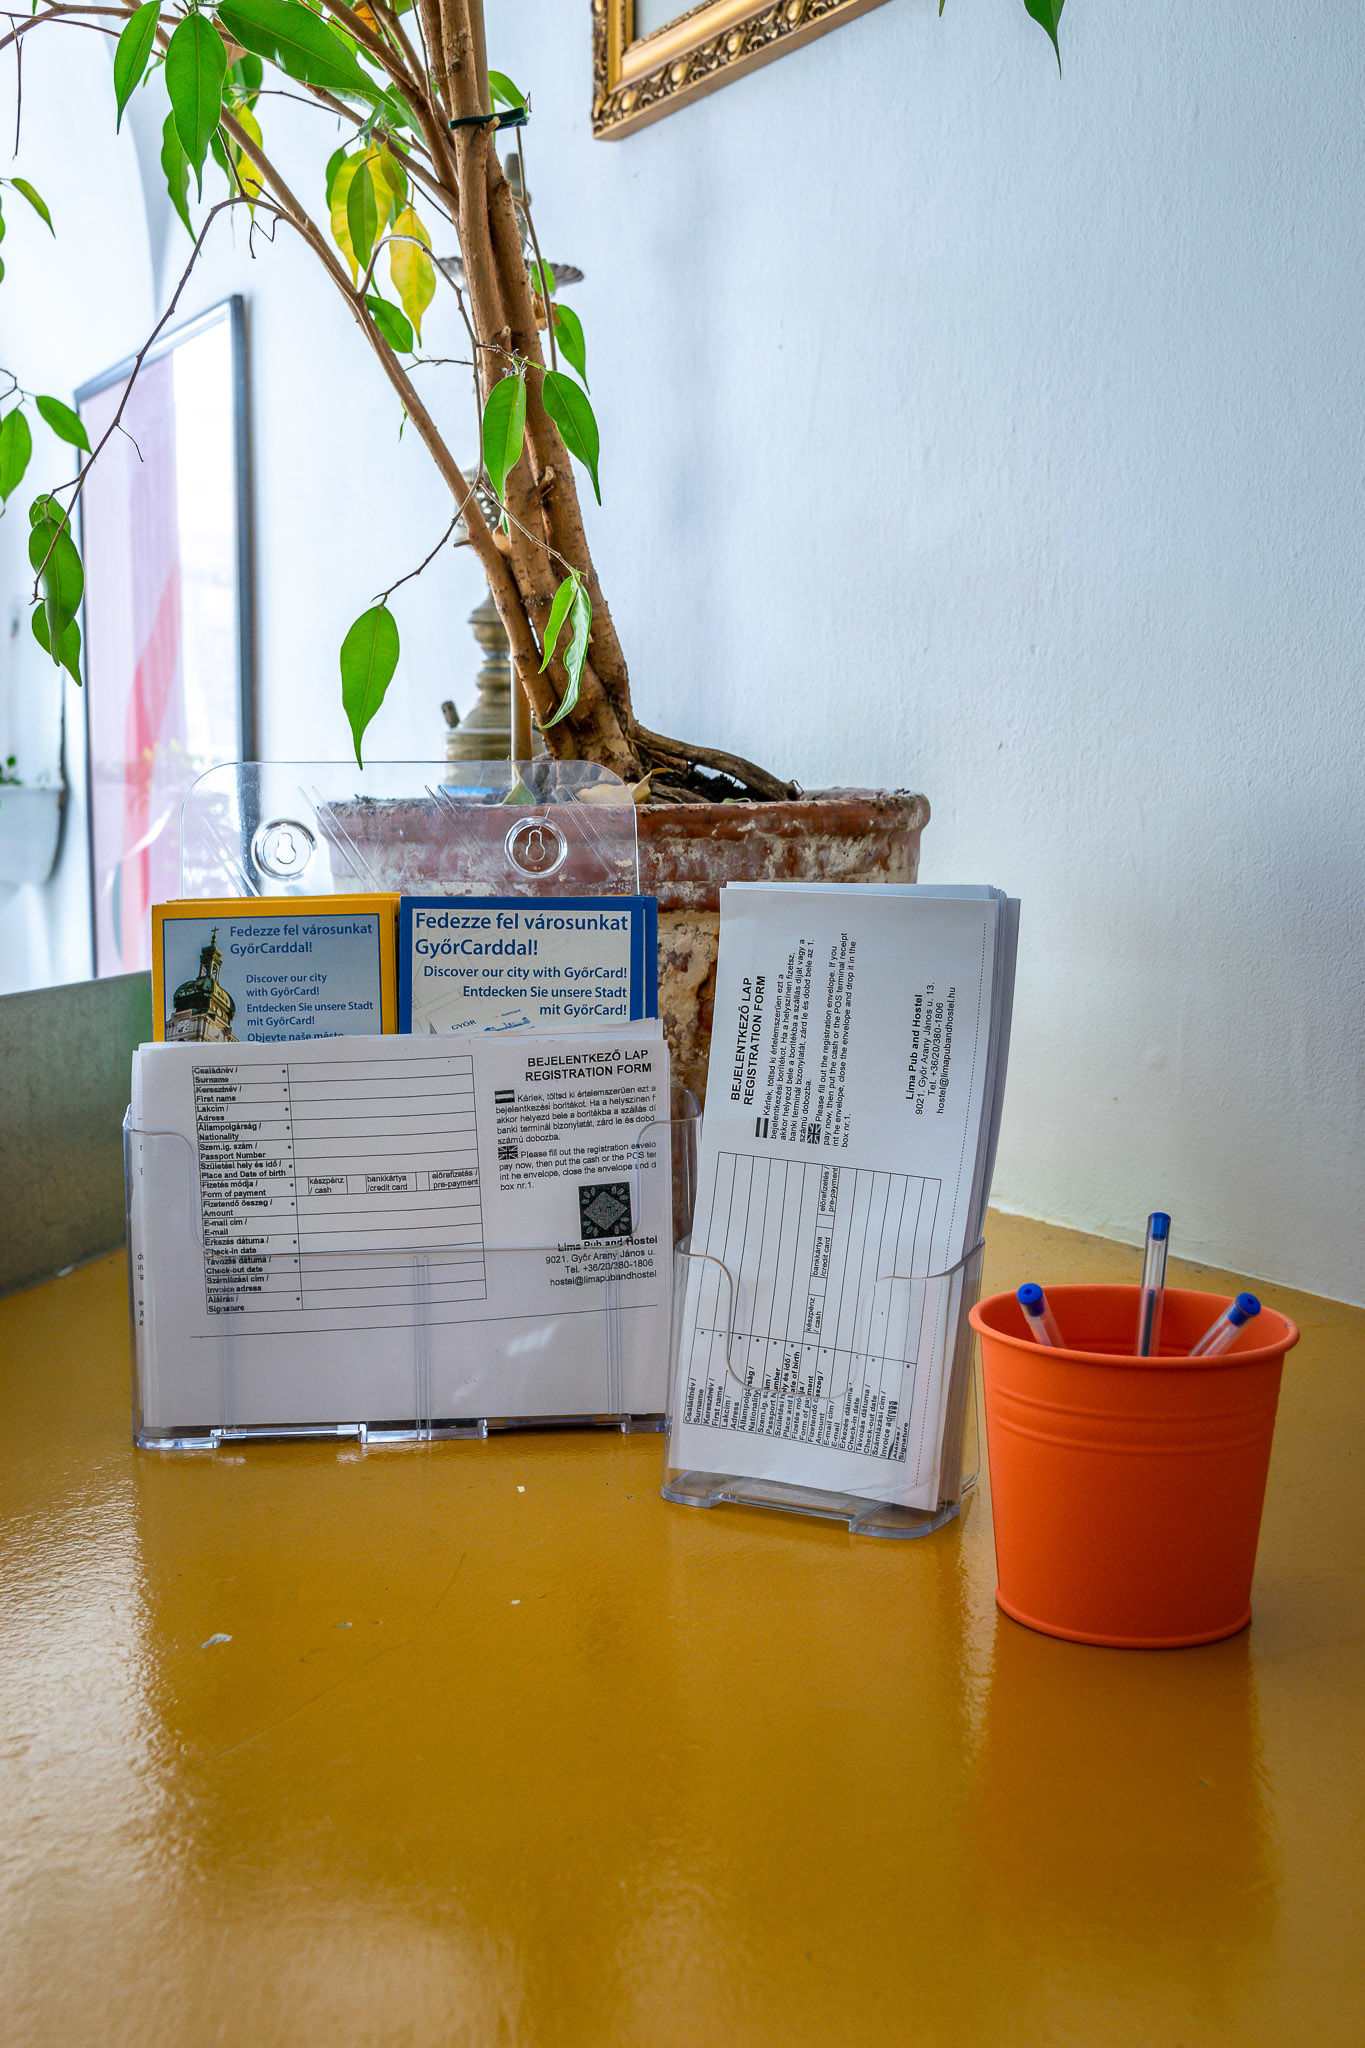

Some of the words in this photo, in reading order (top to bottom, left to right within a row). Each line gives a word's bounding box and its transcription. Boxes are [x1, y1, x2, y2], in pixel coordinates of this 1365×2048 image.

[230, 925, 280, 937] Fedezze
[284, 925, 299, 936] fel
[302, 923, 372, 935] városunkat
[416, 912, 491, 929] Fedezze
[497, 913, 518, 929] fel
[524, 913, 628, 930] városunkat
[230, 941, 312, 957] GyőrCarddal!
[415, 939, 538, 959] GyőrCarddal!
[807, 949, 813, 958] az
[840, 932, 848, 959] receipt
[424, 966, 478, 977] Discover
[482, 969, 504, 977] our
[507, 966, 529, 980] city
[533, 966, 560, 978] with
[564, 967, 627, 981] GyőrCard!
[804, 960, 812, 976] bele
[836, 961, 844, 992] terminal
[247, 974, 288, 984] Discover
[310, 973, 327, 984] city
[846, 972, 855, 989] drop
[247, 987, 267, 997] with
[271, 986, 319, 998] GyőrCard!
[463, 986, 527, 997] Entdecken
[530, 986, 548, 997] Sie
[551, 989, 592, 997] unsere
[595, 986, 627, 998] Stadt
[802, 979, 810, 998] dobd
[826, 970, 836, 1007] envelope.
[926, 982, 934, 995] 13.
[247, 1003, 296, 1012] Entdecken
[299, 1002, 312, 1011] Sie
[348, 1000, 373, 1010] Stadt
[540, 1004, 560, 1015] mit
[564, 1004, 626, 1018] GyőrCard!
[802, 1000, 808, 1010] és
[834, 994, 842, 1013] POS
[912, 994, 922, 1026] Hostel
[927, 998, 933, 1006] u.
[247, 1017, 263, 1026] mit
[267, 1016, 315, 1028] GyőrCard!
[842, 1009, 851, 1044] envelope
[923, 1009, 932, 1035] János
[248, 1032, 286, 1043] Objevte
[730, 1005, 749, 1100] BEJELENTKEZŐ
[741, 977, 752, 1001] LAP
[744, 1014, 761, 1104] REGISTRATION
[754, 976, 765, 1010] FORM
[822, 1010, 832, 1053] registration
[833, 1030, 838, 1038] or
[930, 1002, 943, 1076] +36/20/380-1806
[528, 1049, 620, 1067] BEJELENTKEZŐ
[625, 1050, 648, 1060] LAP
[920, 1038, 931, 1063] Arany
[936, 987, 956, 1114] hostel@limapubandhostel.hu
[795, 1041, 806, 1084] bizonylatát,
[908, 1052, 917, 1071] Pub
[525, 1066, 612, 1081] REGISTRATION
[617, 1063, 651, 1074] FORM
[828, 1076, 836, 1088] put
[906, 1075, 915, 1099] Lima
[928, 1080, 936, 1095] Tel.
[763, 1089, 773, 1115] Kérlek,
[791, 1087, 800, 1117] terminál
[802, 1079, 811, 1114] dobozba.
[835, 1085, 844, 1122] envelope,
[915, 1090, 924, 1114] 9021.
[815, 1095, 823, 1121] Please
[199, 1133, 239, 1141] Nationality
[788, 1120, 797, 1141] banki
[799, 1116, 807, 1142] számú
[833, 1124, 839, 1134] he
[200, 1153, 233, 1161] Passport
[433, 1179, 478, 1189] pre-payment
[233, 1190, 266, 1198] payment
[626, 1235, 657, 1245] Hostel
[545, 1255, 568, 1264] 9021.
[593, 1252, 617, 1260] Arany
[620, 1250, 644, 1258] János
[565, 1265, 579, 1273] Tel.
